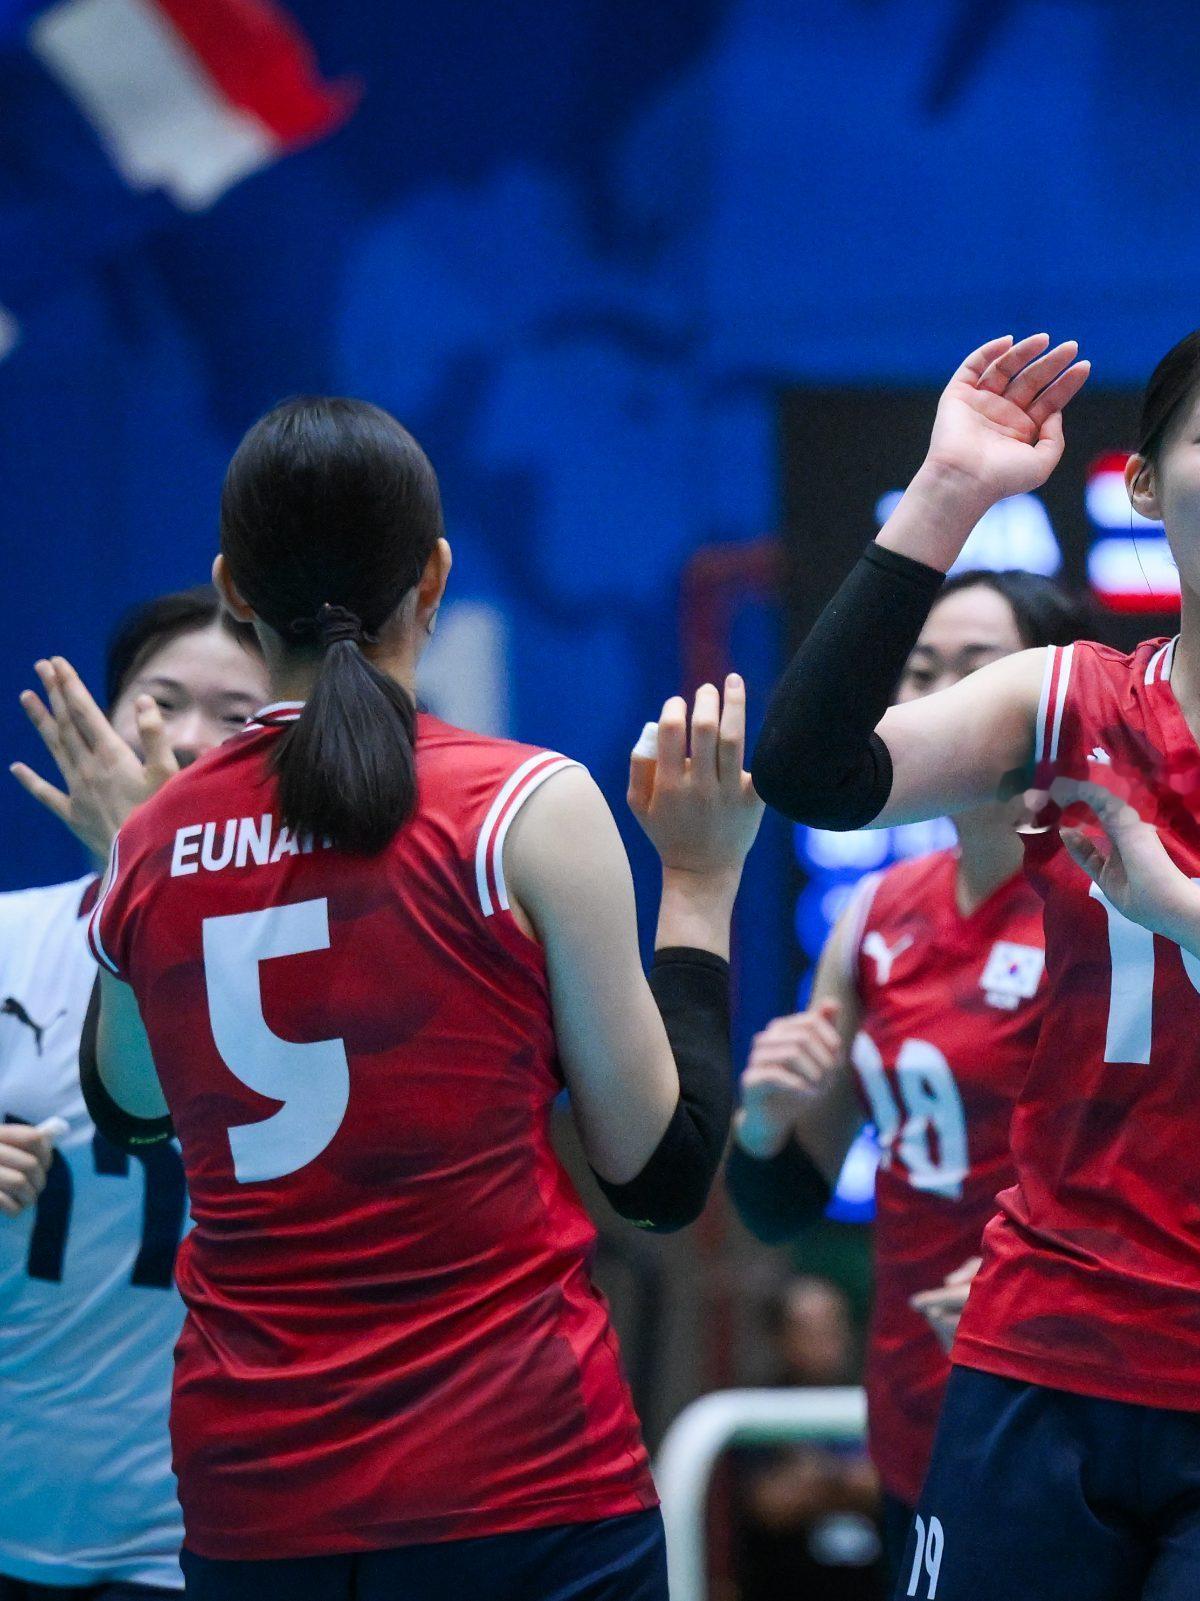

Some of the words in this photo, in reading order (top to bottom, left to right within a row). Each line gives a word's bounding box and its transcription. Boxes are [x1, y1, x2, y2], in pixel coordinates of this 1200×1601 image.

[170, 813, 333, 878] EUNA
[202, 897, 350, 1184] 5
[906, 1513, 945, 1600] 19
